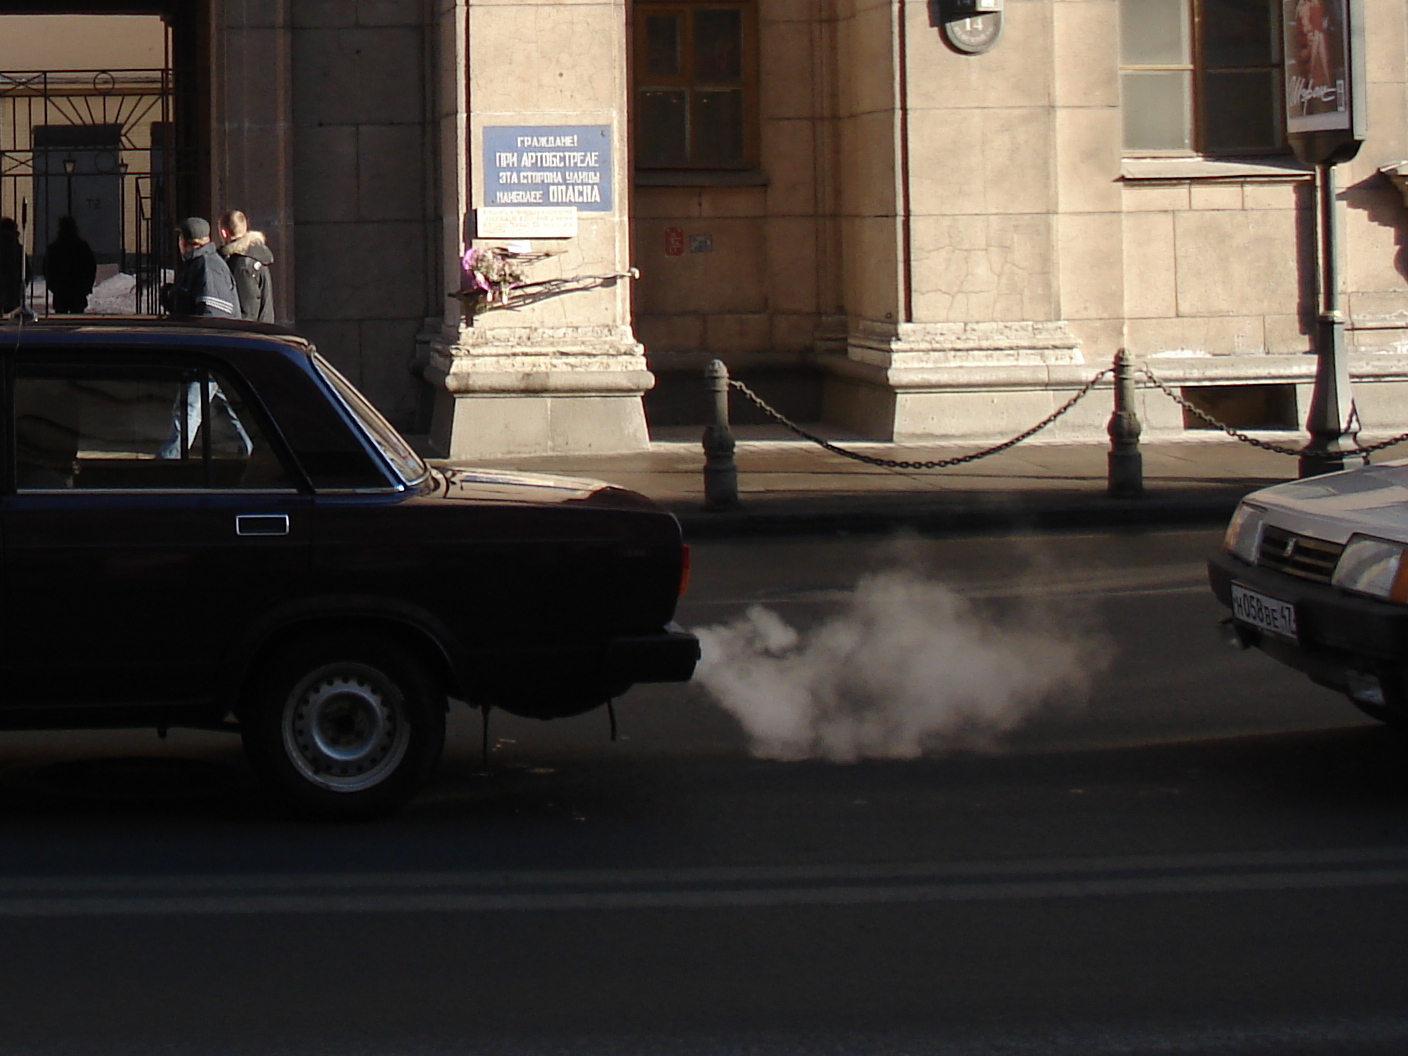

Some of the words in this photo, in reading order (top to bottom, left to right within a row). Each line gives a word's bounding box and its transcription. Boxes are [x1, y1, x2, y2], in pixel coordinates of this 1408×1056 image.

[964, 17, 983, 31] 14
[517, 135, 578, 148] ГРАЖДАНЕ!
[496, 152, 517, 167] ПРИ
[521, 152, 599, 167] АРТОБСТРЕЛЕ
[499, 171, 518, 184] ЭТА
[520, 171, 562, 184] СТОРОНА
[565, 171, 600, 184] УЛИЦЫ
[496, 190, 543, 204] НАИБОЛЕЕ
[549, 184, 601, 203] ОПАСНА
